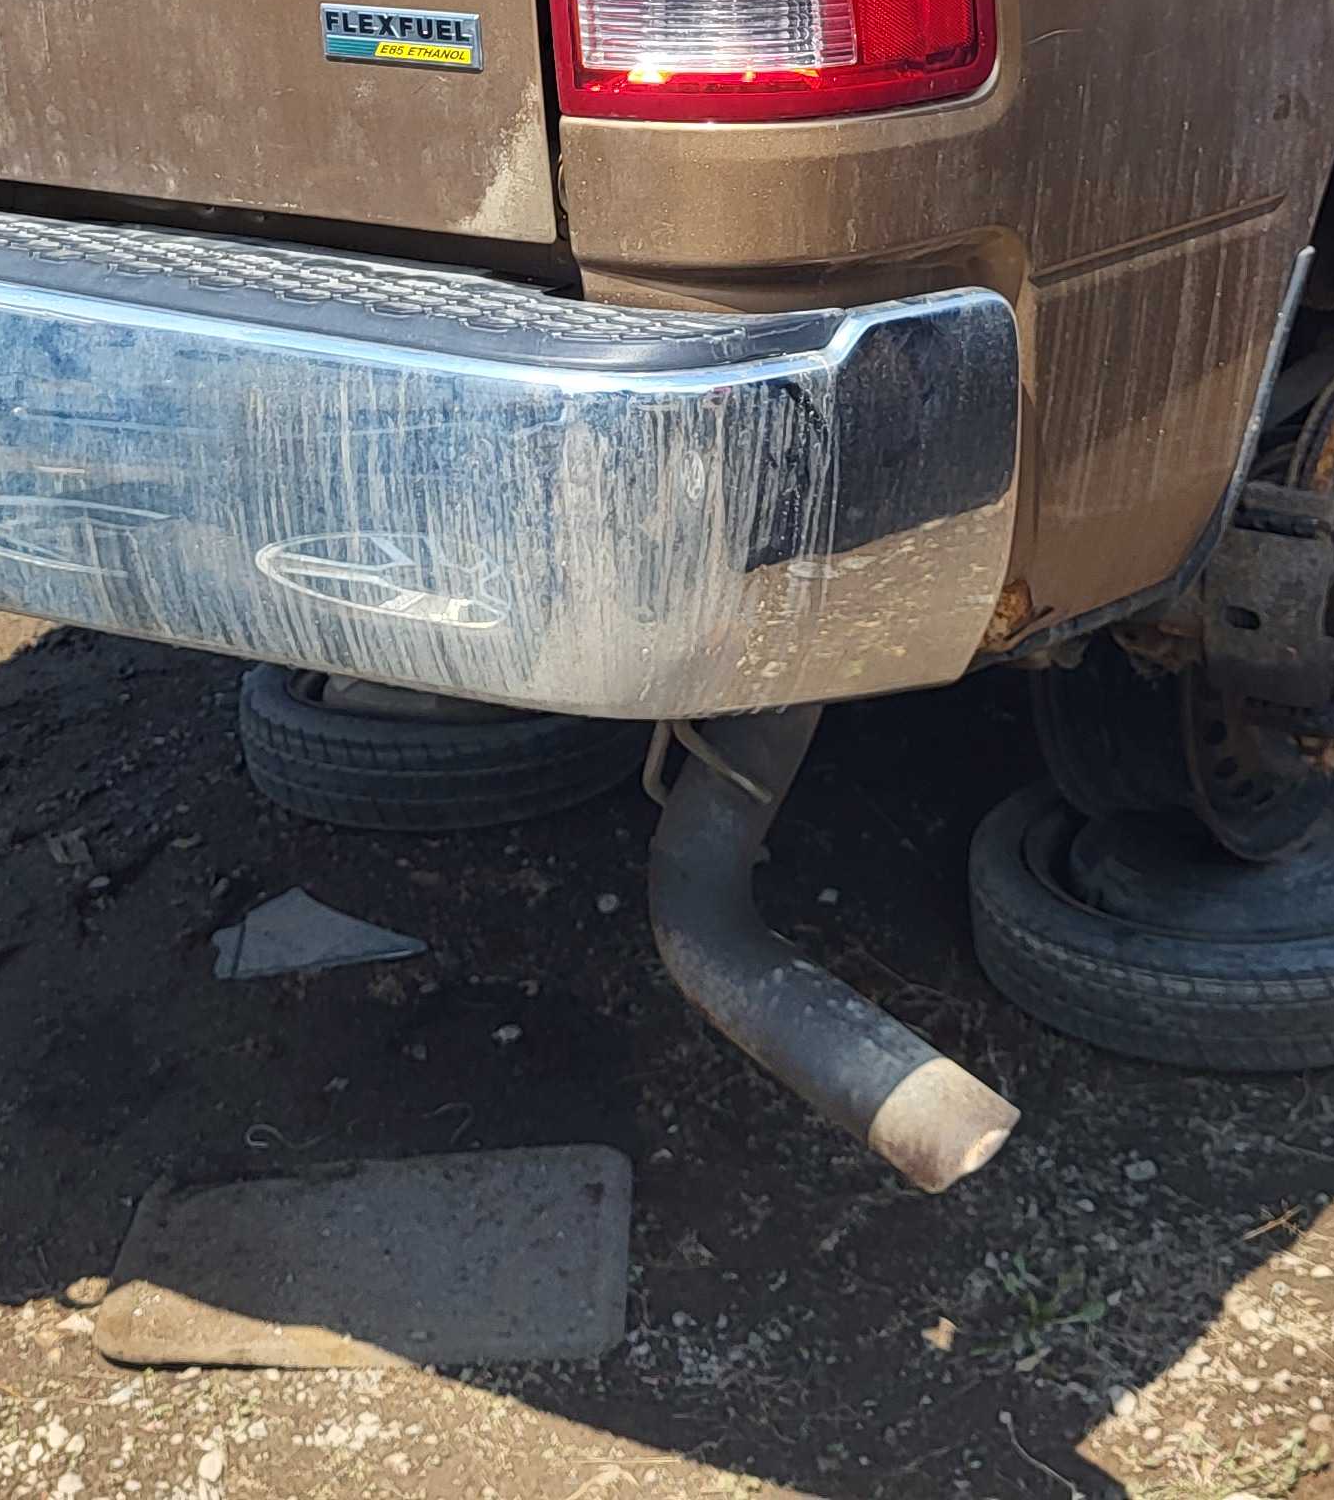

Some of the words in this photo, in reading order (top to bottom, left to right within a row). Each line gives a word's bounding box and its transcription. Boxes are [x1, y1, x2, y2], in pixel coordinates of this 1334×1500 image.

[324, 10, 471, 43] FLEXFUEL
[379, 44, 404, 56] E85
[407, 46, 466, 61] ETHANOL
